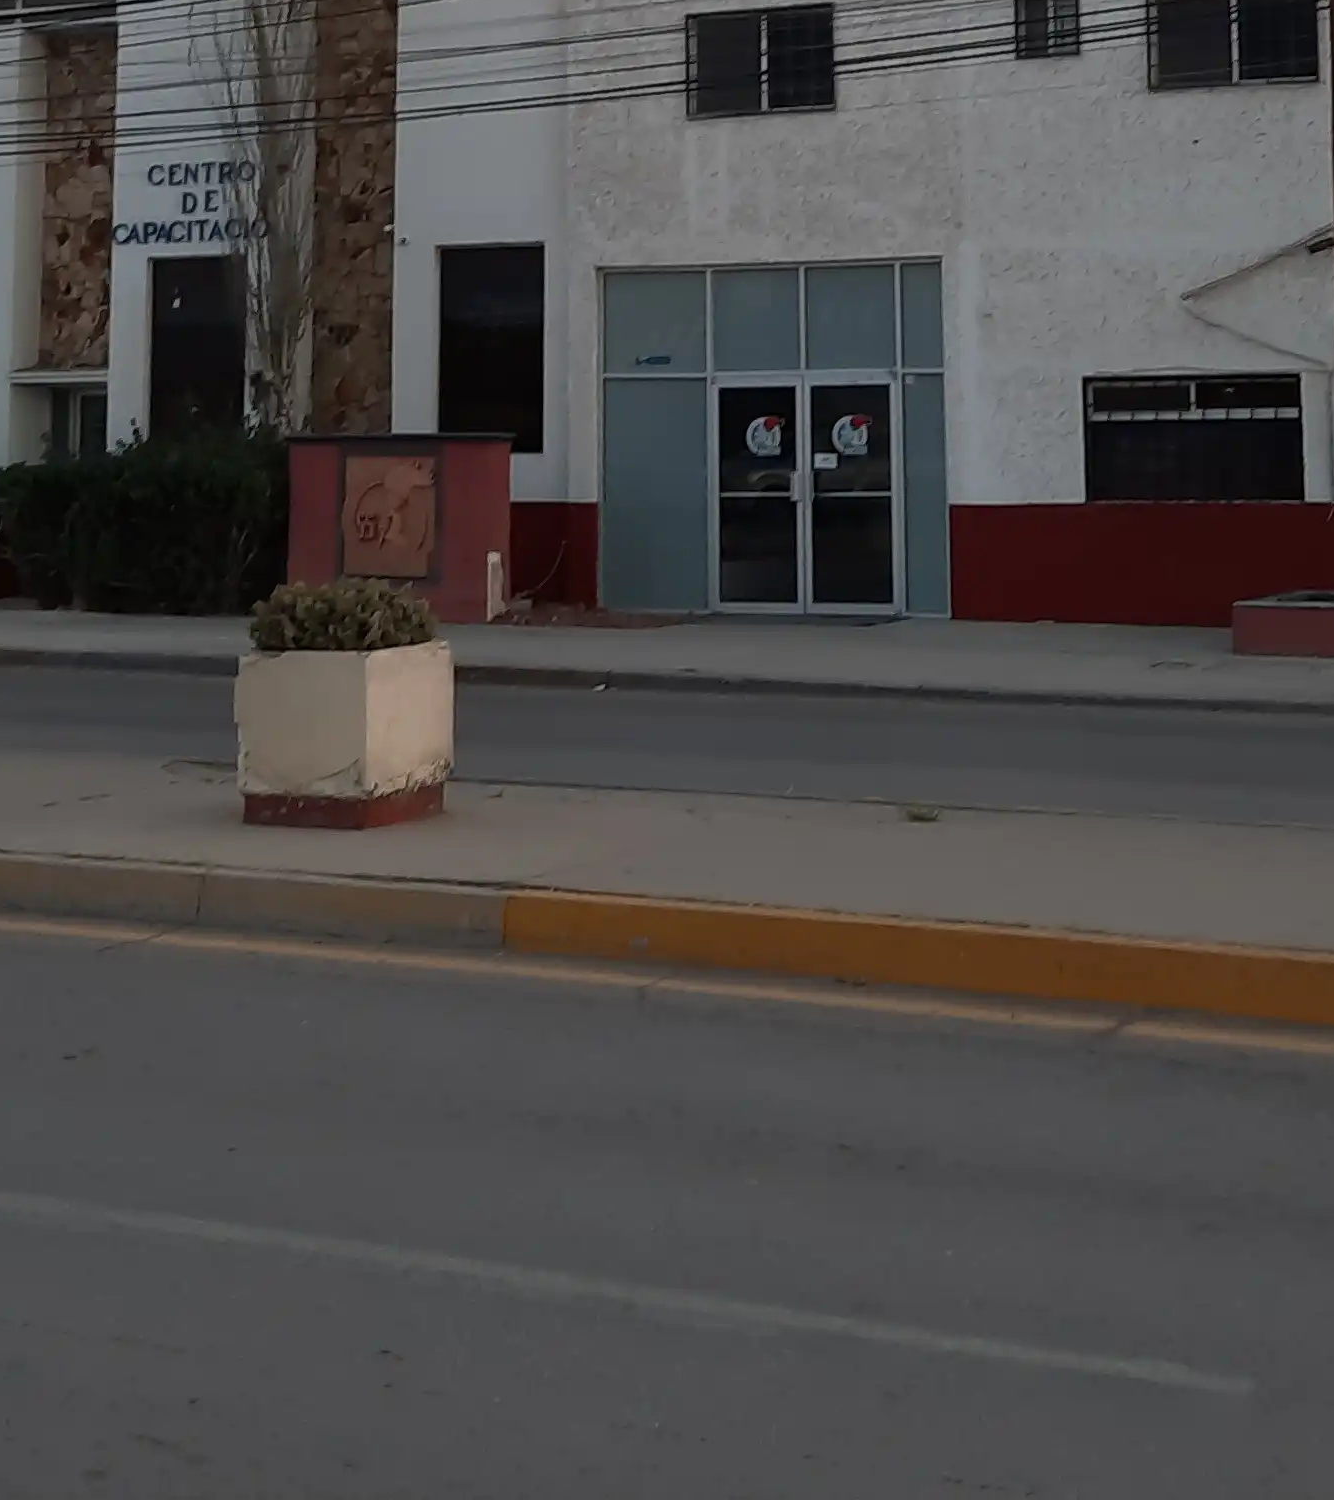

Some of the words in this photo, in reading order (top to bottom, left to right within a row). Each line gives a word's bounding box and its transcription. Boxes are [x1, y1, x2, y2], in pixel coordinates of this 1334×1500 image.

[147, 160, 255, 187] CENTRO
[181, 189, 219, 215] DE
[113, 218, 269, 245] CAPACITACIO
